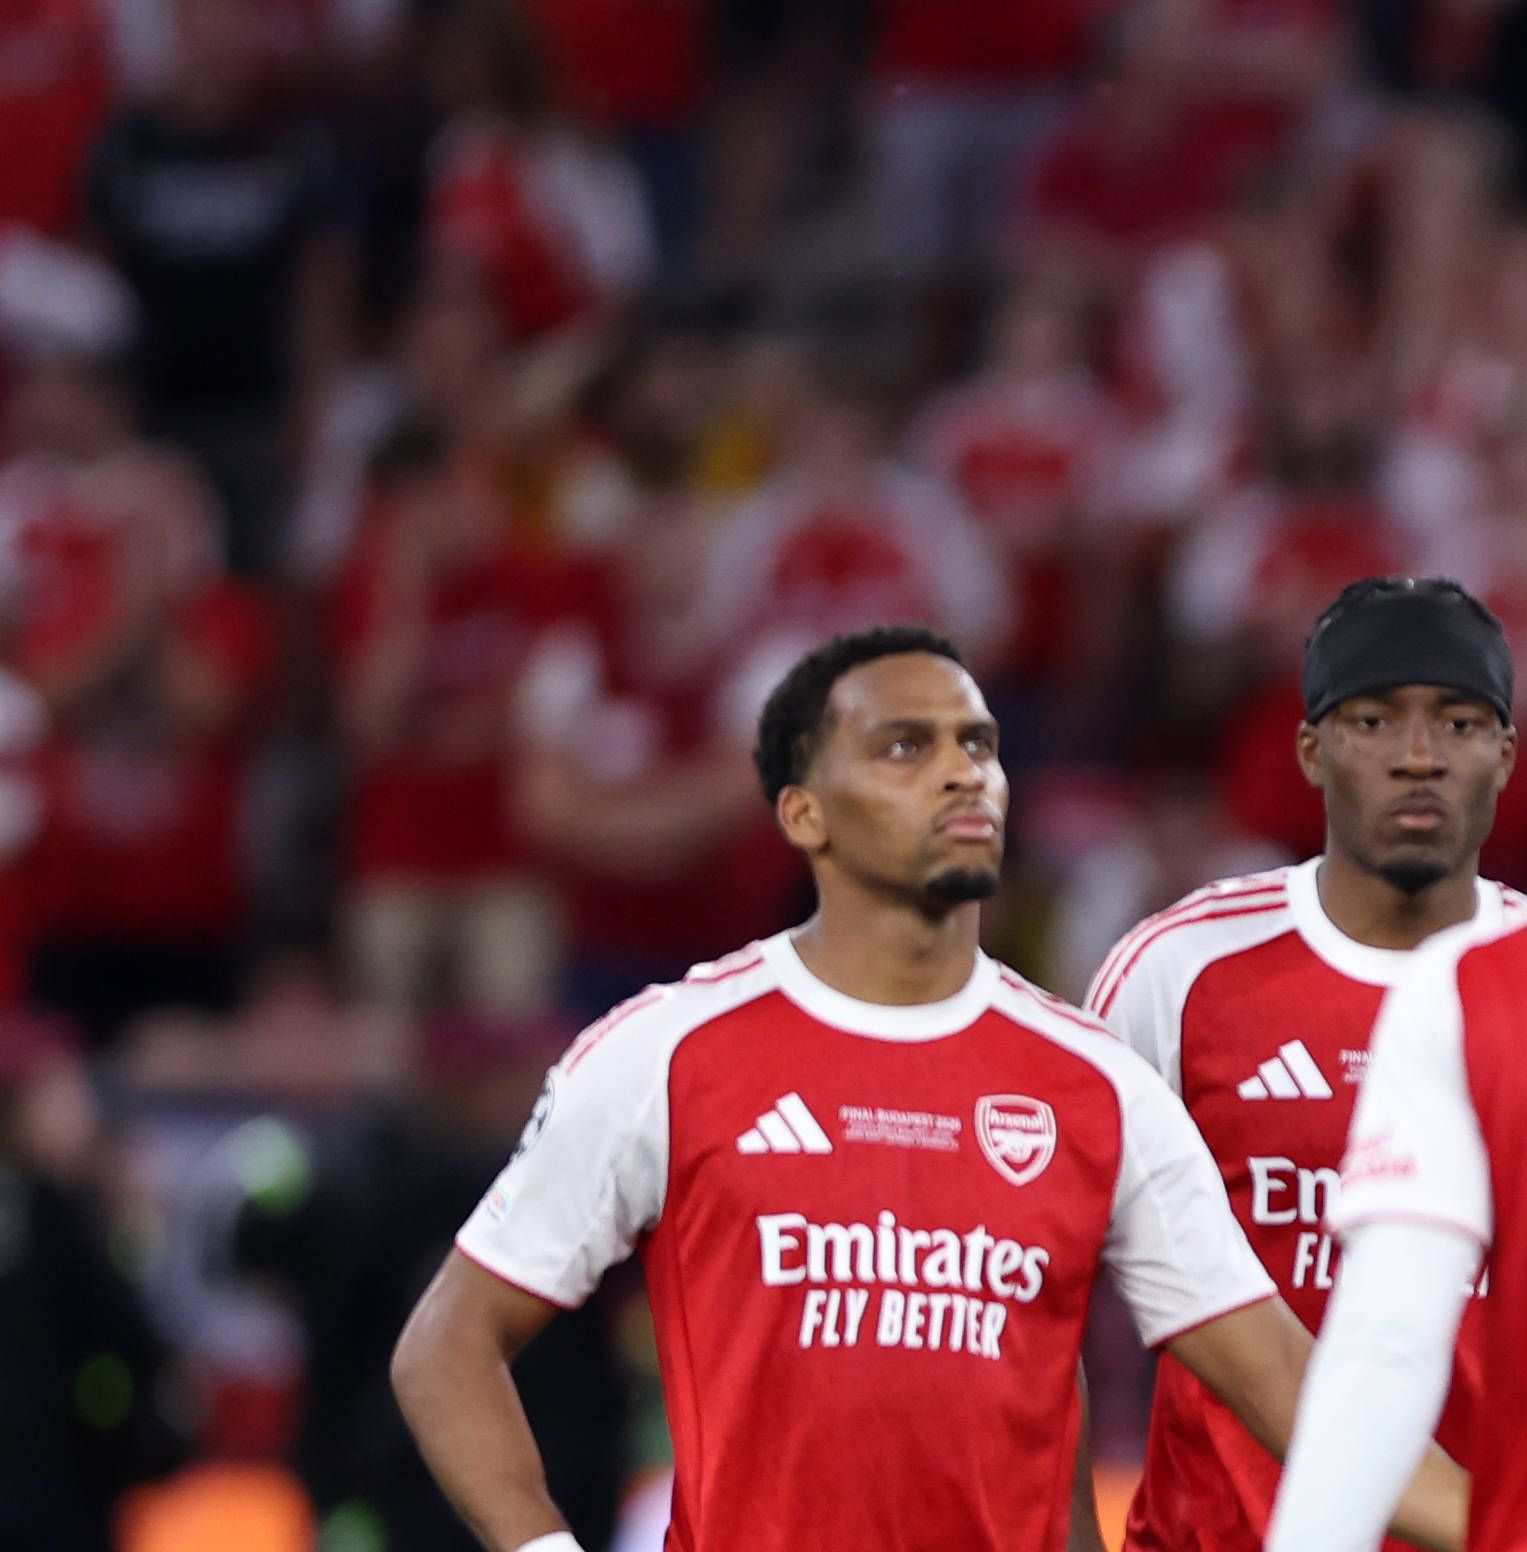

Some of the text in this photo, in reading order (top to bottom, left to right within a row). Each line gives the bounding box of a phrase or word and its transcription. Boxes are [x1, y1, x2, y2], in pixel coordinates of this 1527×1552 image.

[757, 1209, 1049, 1303] Emirates
[799, 1288, 1008, 1360] FLY BETTER
